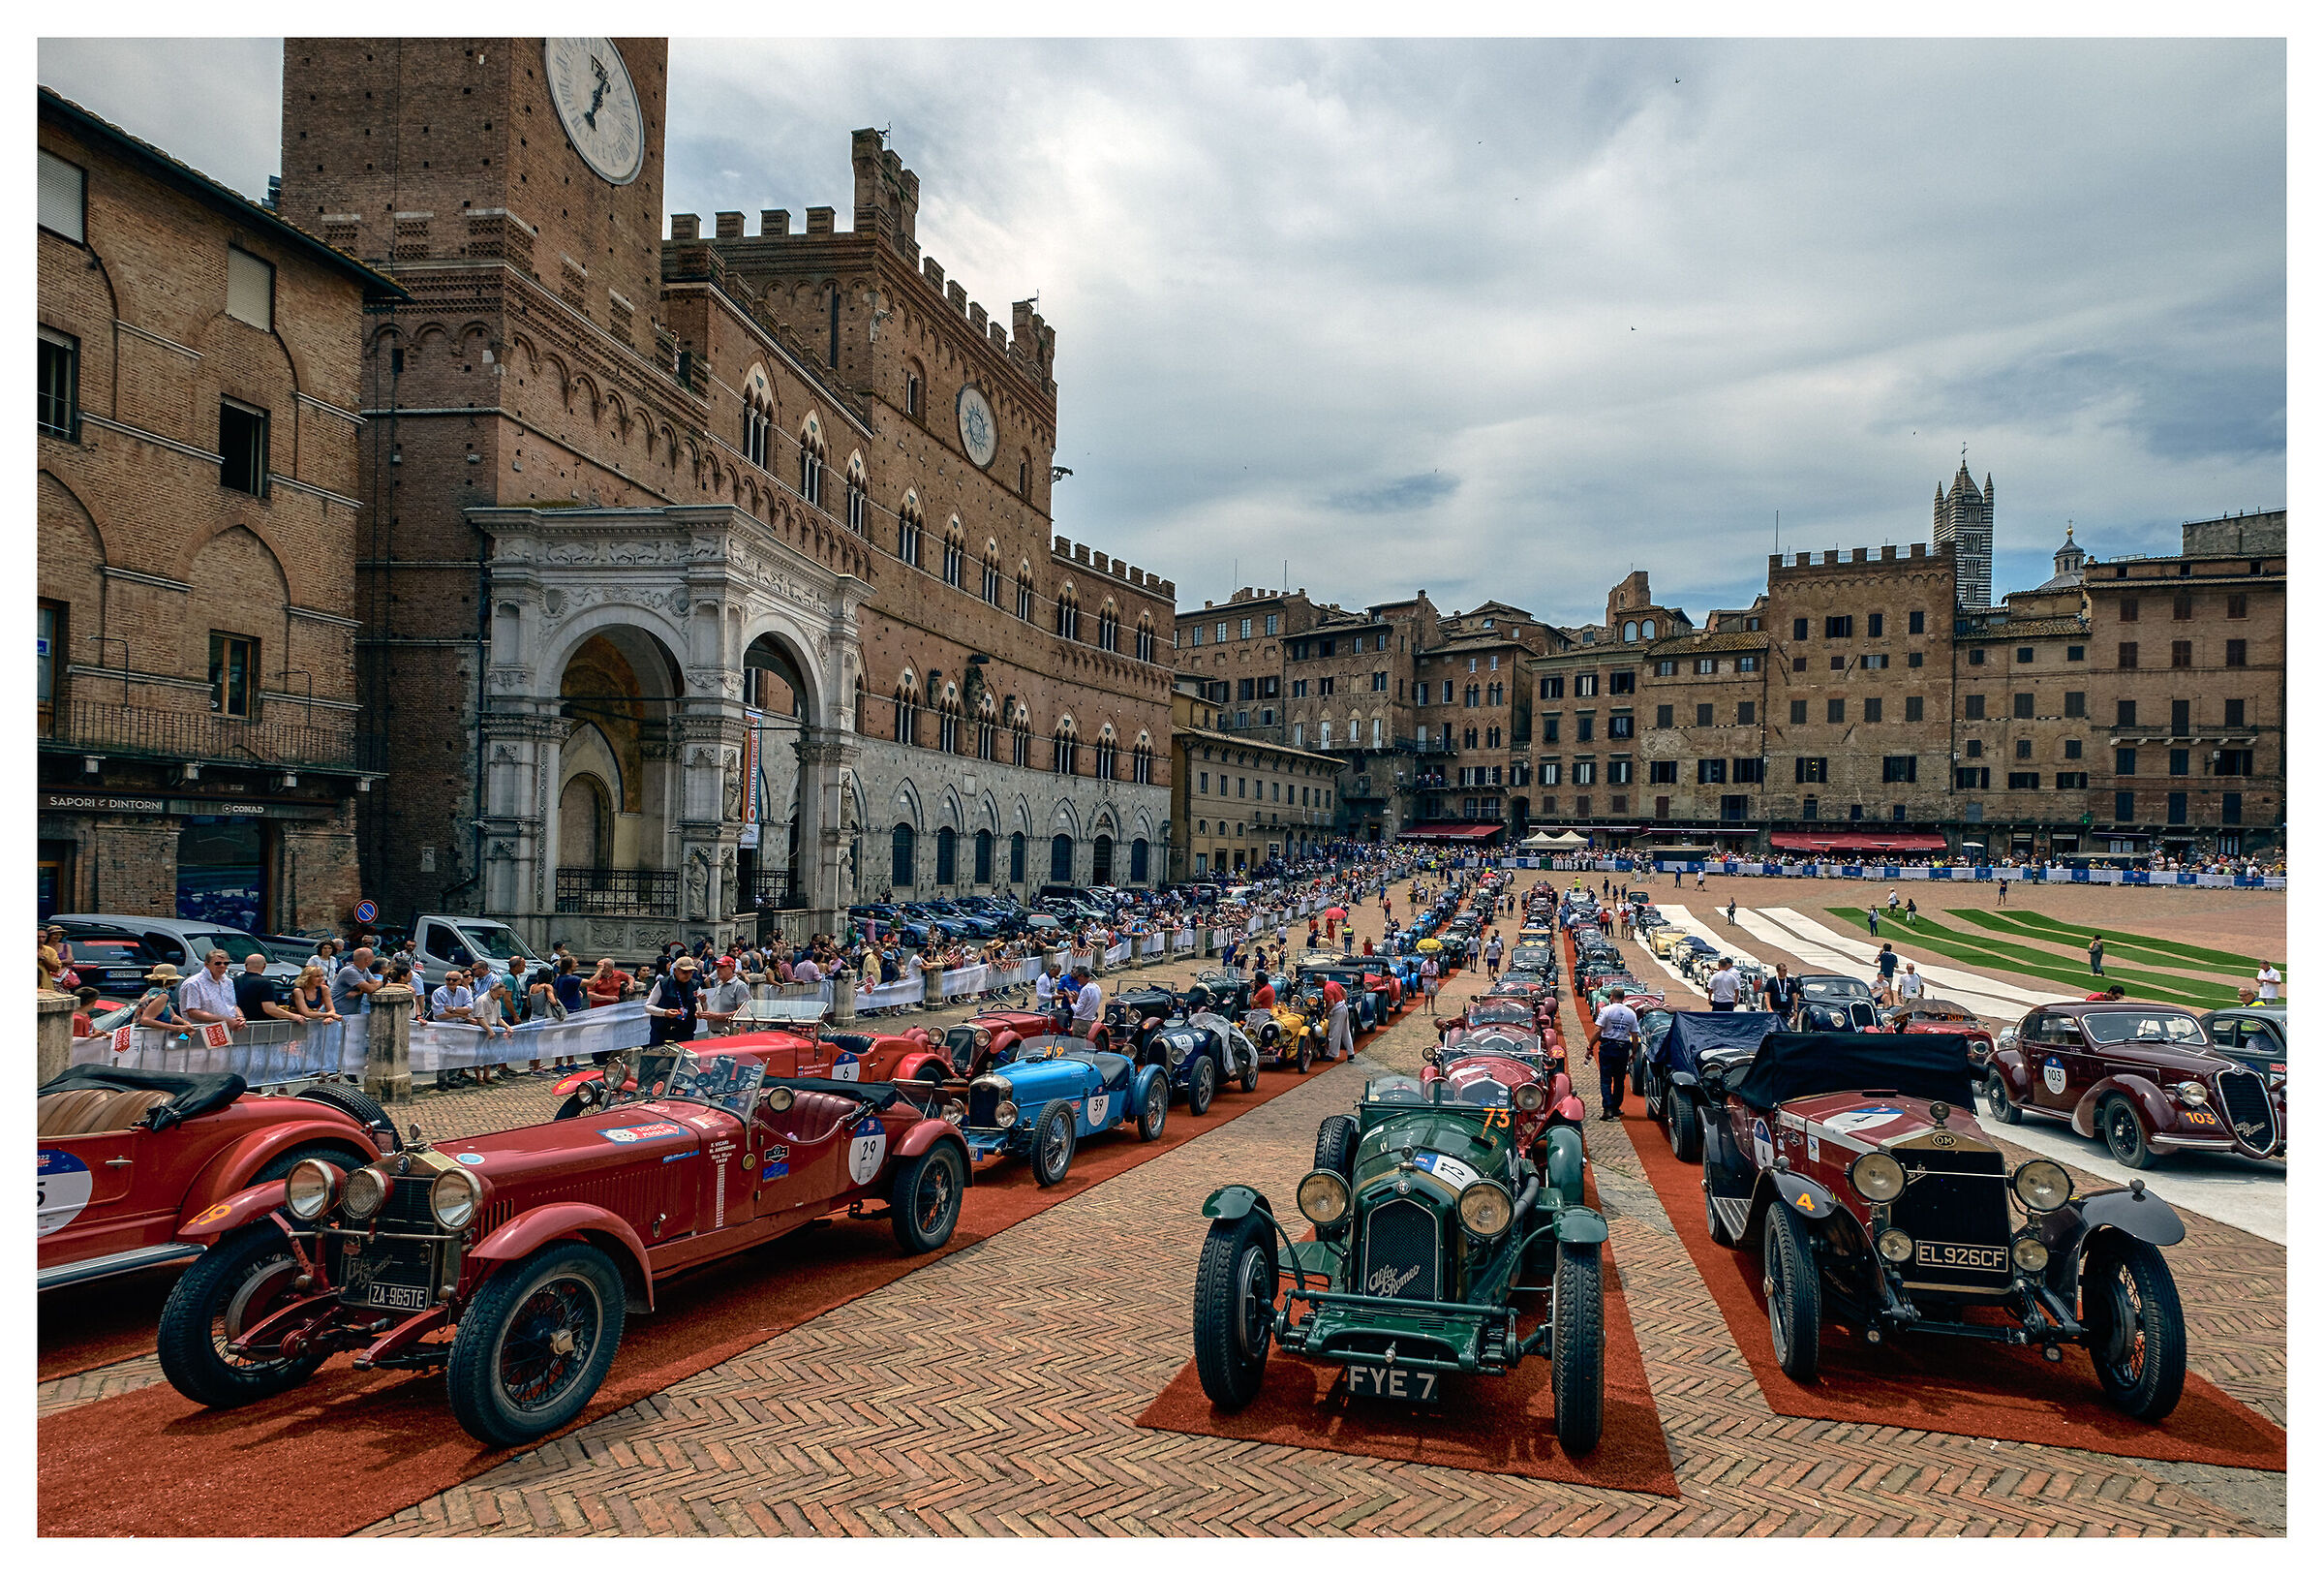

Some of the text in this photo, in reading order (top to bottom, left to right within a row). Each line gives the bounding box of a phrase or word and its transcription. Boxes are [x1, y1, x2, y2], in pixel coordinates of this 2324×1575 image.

[49, 796, 96, 808] SAPORI
[109, 799, 164, 811] DINTORNI
[232, 805, 264, 814] CONAD
[215, 1026, 226, 1042] 1000
[1044, 1046, 1064, 1058] 39
[842, 1066, 849, 1079] 6
[2047, 1069, 2062, 1082] 103
[1093, 1098, 1104, 1112] 39
[1483, 1107, 1511, 1129] 73
[1851, 1115, 1873, 1124] 4
[2185, 1111, 2216, 1126] 103
[636, 1124, 665, 1132] 1000
[642, 1127, 675, 1138] MIGLIA
[1936, 1135, 1954, 1145] OM
[860, 1140, 876, 1161] 29
[1761, 1145, 1768, 1162] 4
[1439, 1162, 1466, 1182] 73
[1796, 1193, 1816, 1211] 4
[1918, 1245, 2005, 1267] EL926CF
[1368, 1264, 1421, 1297] Alfa Romeo
[371, 1284, 425, 1309] ZA-965TE
[1349, 1365, 1436, 1400] FYE 7
